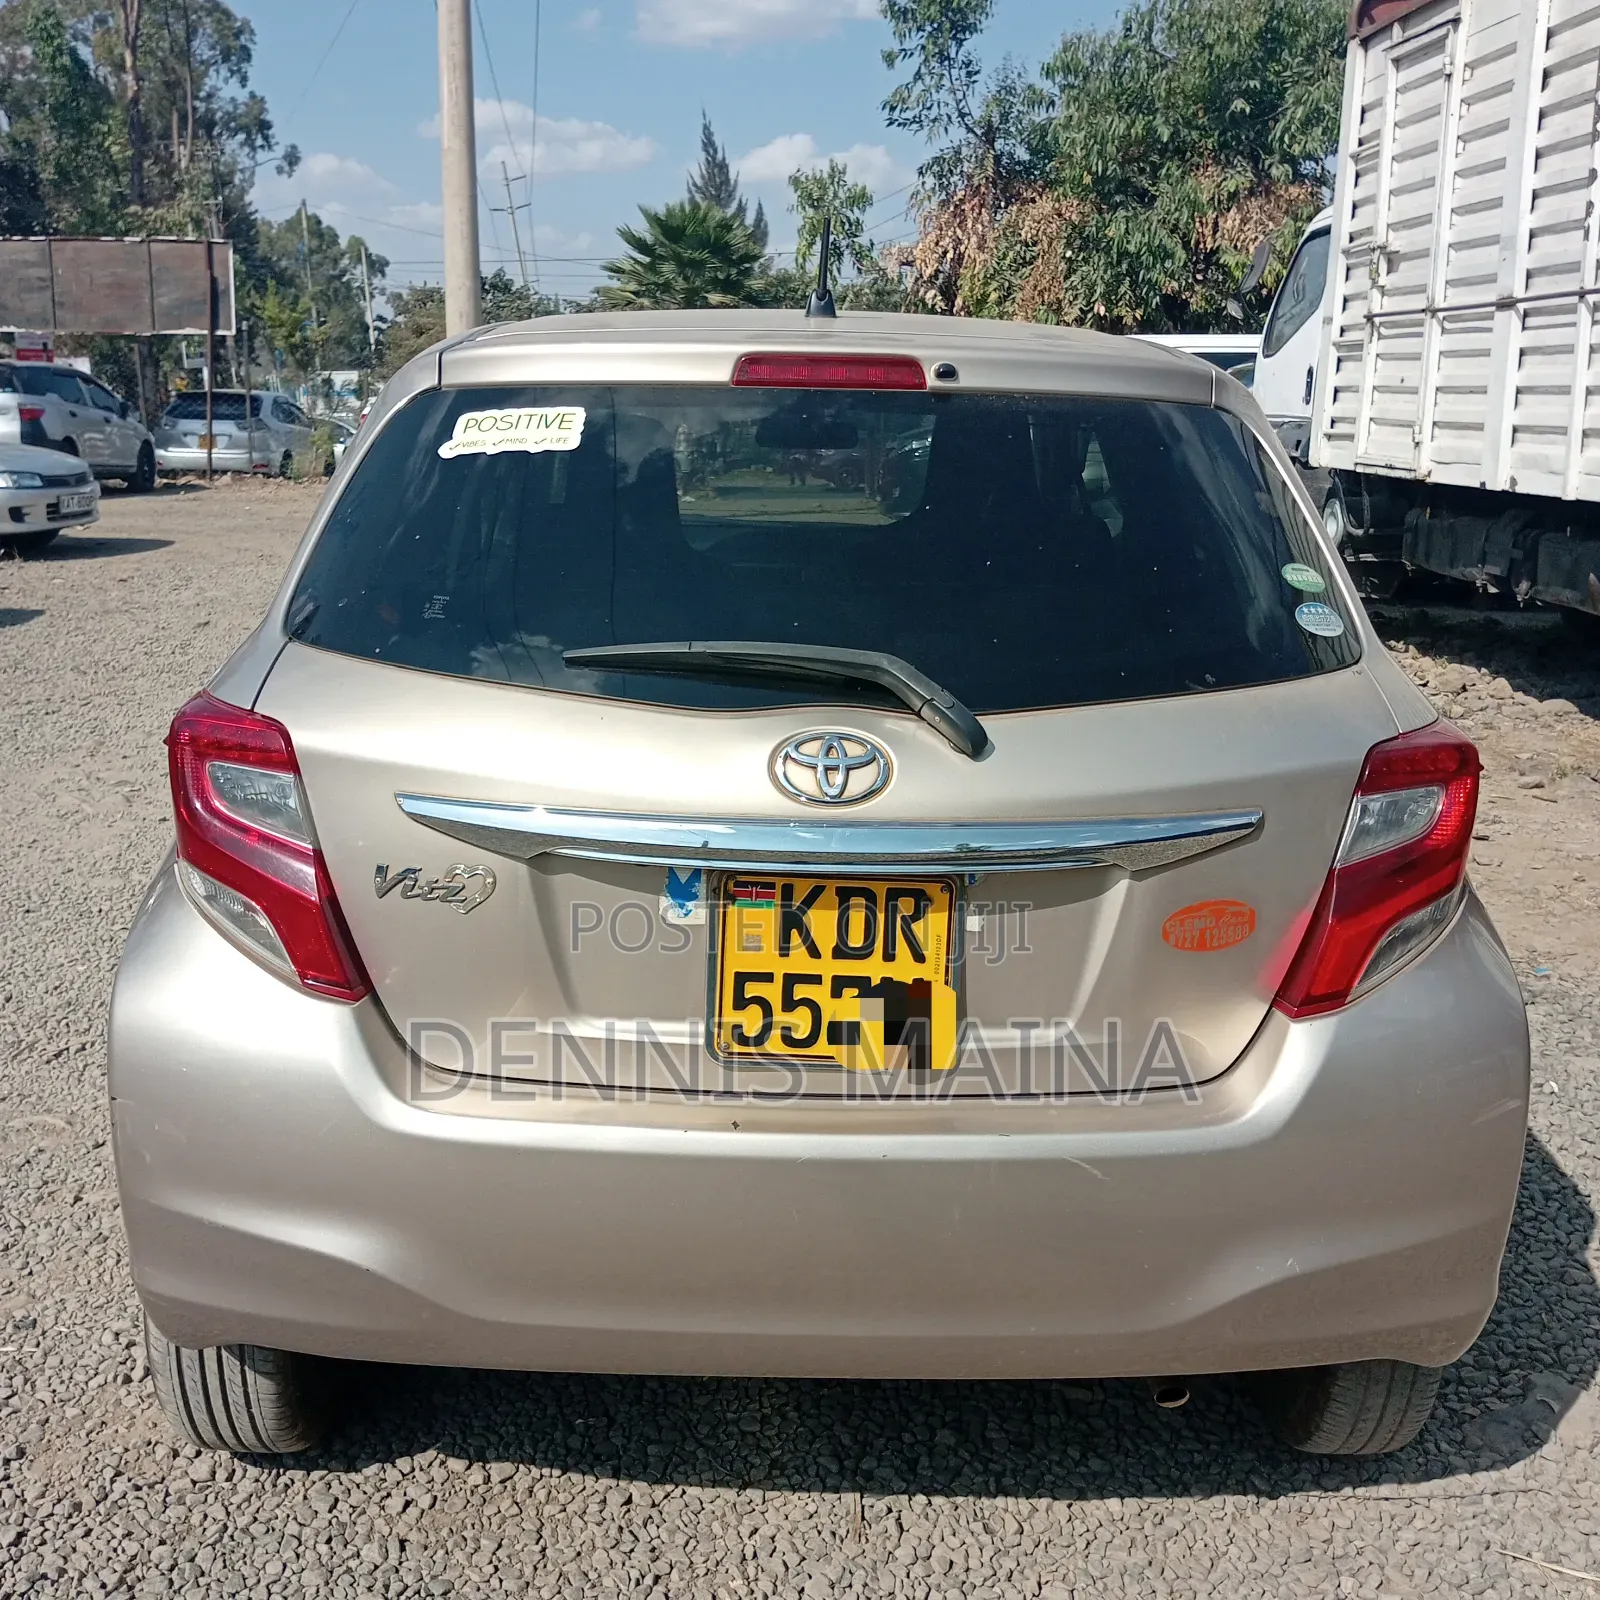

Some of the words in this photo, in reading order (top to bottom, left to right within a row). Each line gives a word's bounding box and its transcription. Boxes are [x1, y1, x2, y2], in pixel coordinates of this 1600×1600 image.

[463, 412, 577, 434] POSITIVE
[462, 439, 487, 448] VIBES
[505, 437, 528, 445] MIND
[549, 437, 570, 445] LIFE
[374, 863, 467, 903] Vitz
[778, 883, 928, 964] KDR
